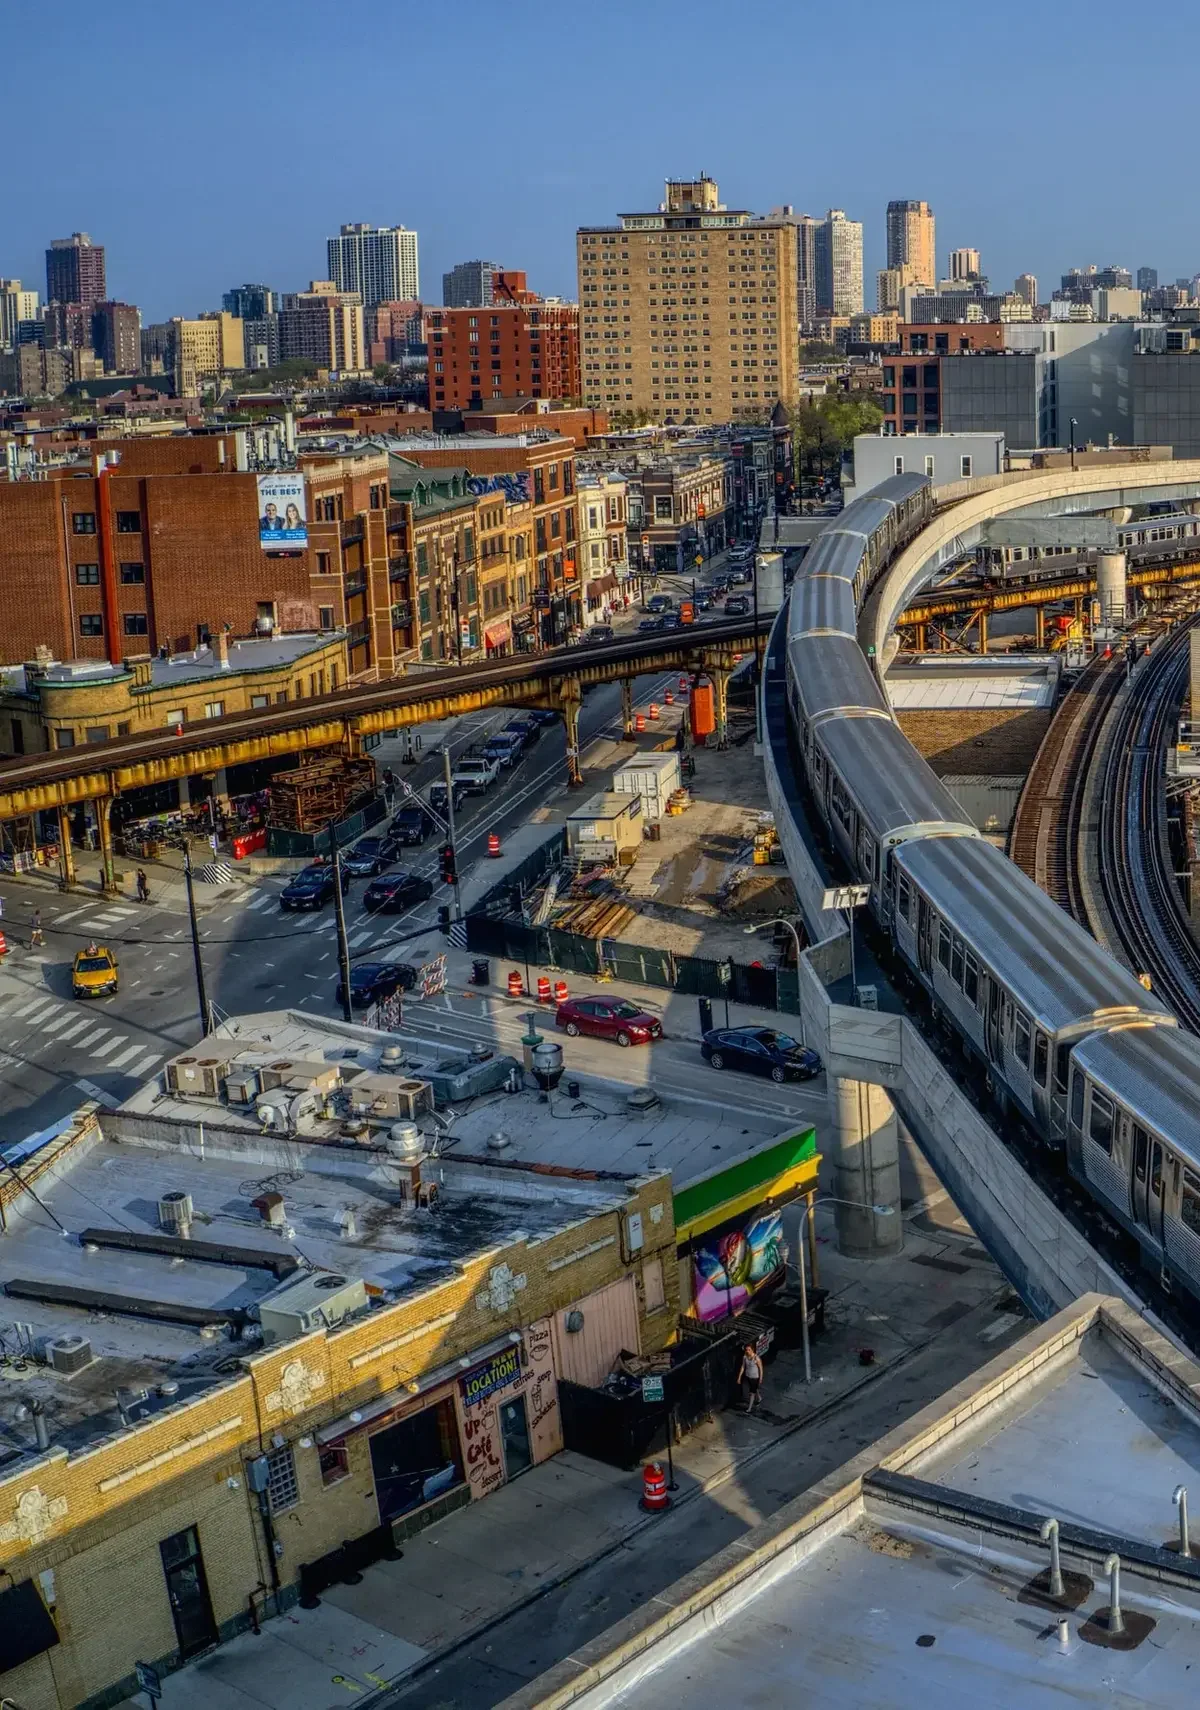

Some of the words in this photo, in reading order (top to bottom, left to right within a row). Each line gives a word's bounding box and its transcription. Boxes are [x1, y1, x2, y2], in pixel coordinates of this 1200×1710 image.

[260, 488, 278, 496] THE
[280, 488, 302, 496] BEST
[529, 1331, 549, 1348] pizza
[492, 1348, 517, 1367] NEW
[466, 1358, 518, 1397] LOCATION!
[467, 1433, 492, 1464] Café
